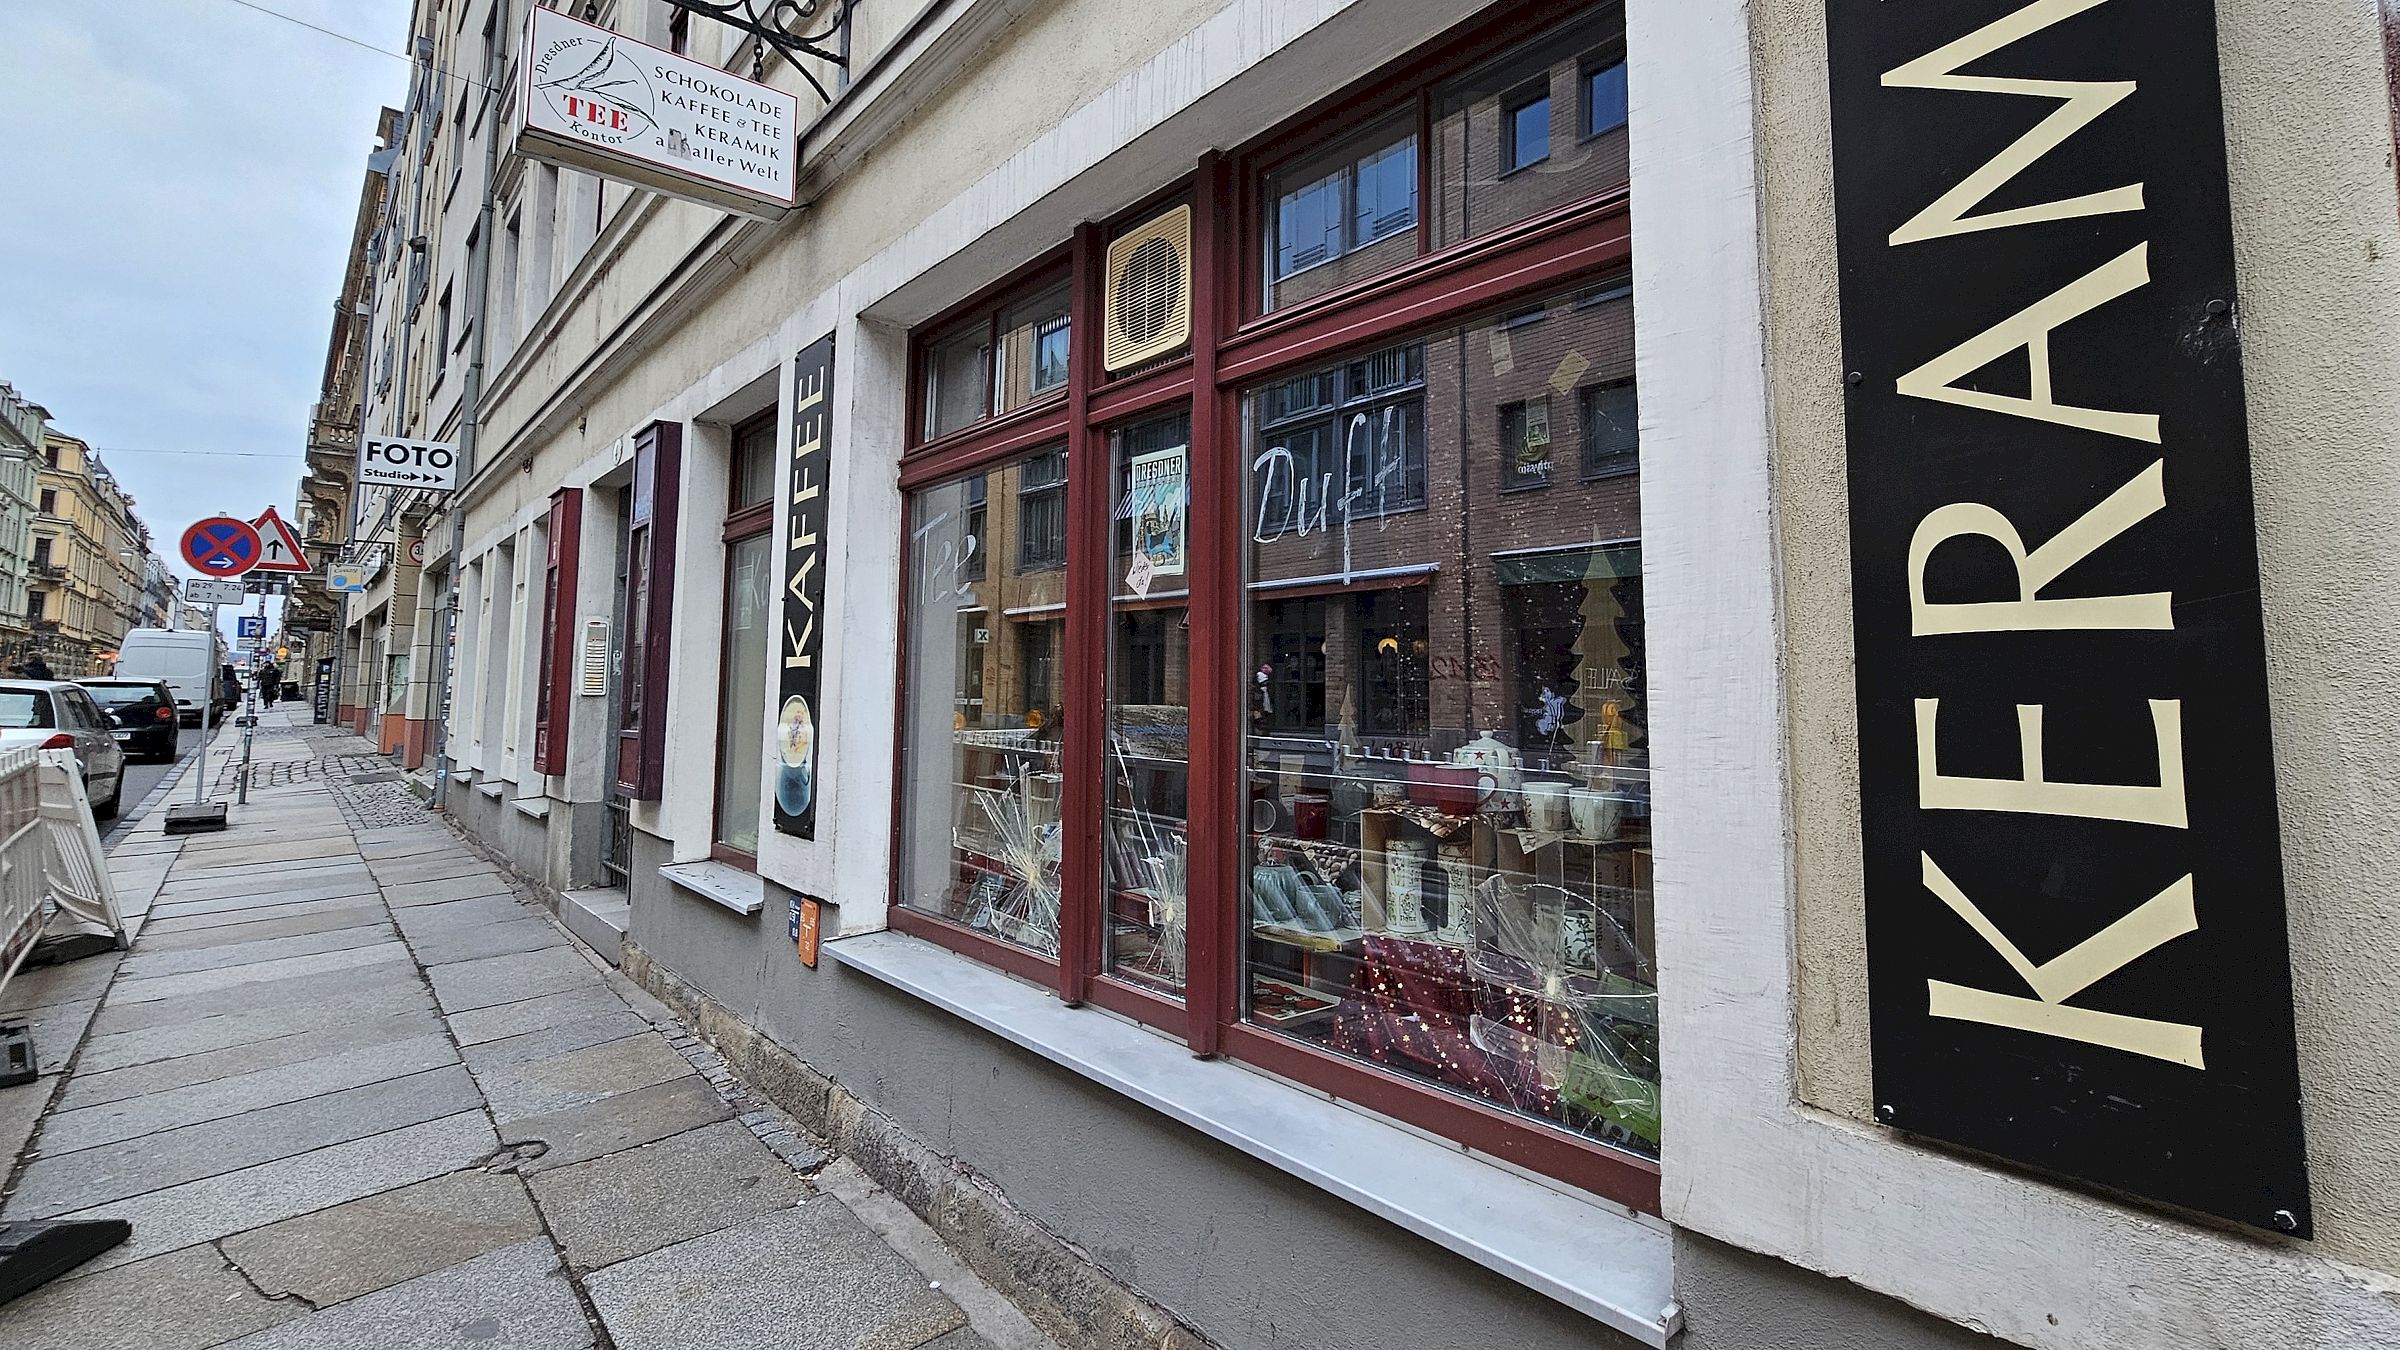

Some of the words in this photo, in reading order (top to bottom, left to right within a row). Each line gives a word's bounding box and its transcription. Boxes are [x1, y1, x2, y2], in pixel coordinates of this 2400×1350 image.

[535, 36, 584, 75] Dresdner
[654, 66, 782, 119] SCHOKOLADE
[562, 94, 628, 133] TEE
[569, 119, 623, 145] Kontor
[661, 90, 730, 124] KAFFEE
[736, 118, 747, 128] &
[750, 119, 781, 140] TEE
[694, 123, 780, 161] KERAMIK
[692, 146, 734, 168] aller
[738, 158, 779, 182] Welt
[364, 468, 410, 480] Studio
[366, 441, 453, 469] FOTO
[1135, 456, 1182, 482] DRESDNER
[1253, 405, 1401, 586] Duft
[785, 365, 825, 669] KAFFEE
[1880, 0, 2205, 1070] KERAM
[912, 512, 977, 605] Tee
